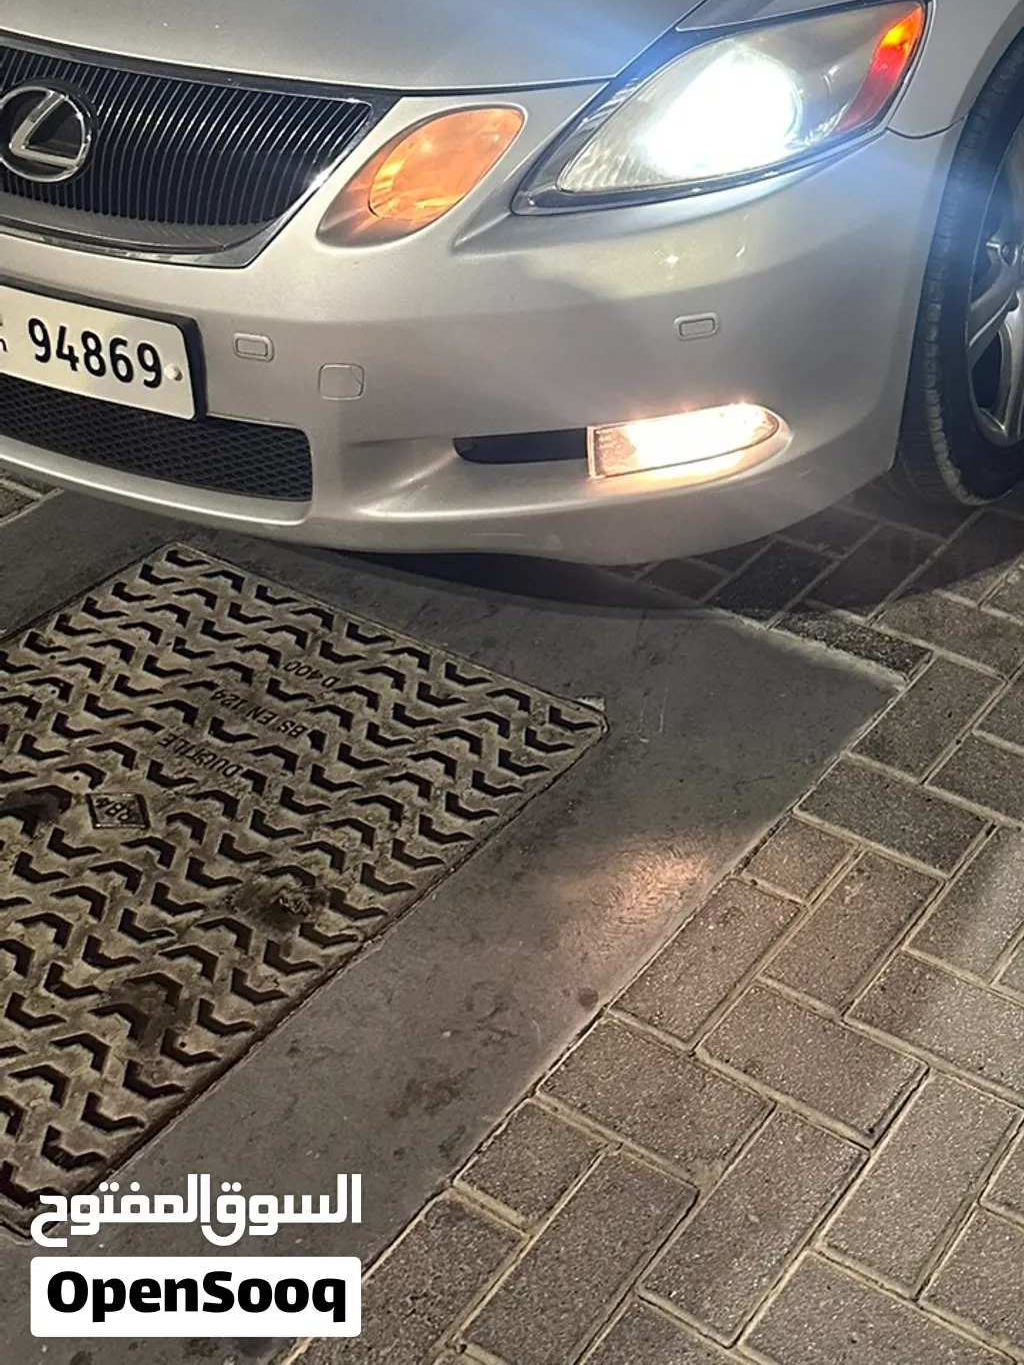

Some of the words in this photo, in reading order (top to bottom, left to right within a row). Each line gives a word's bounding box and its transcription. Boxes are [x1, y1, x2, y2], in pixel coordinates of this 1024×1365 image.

[28, 317, 162, 389] 94869
[283, 660, 323, 680] 400
[209, 689, 249, 711] 124
[246, 705, 279, 725] EN
[277, 720, 308, 739] BS
[157, 733, 244, 778] DUCTILE
